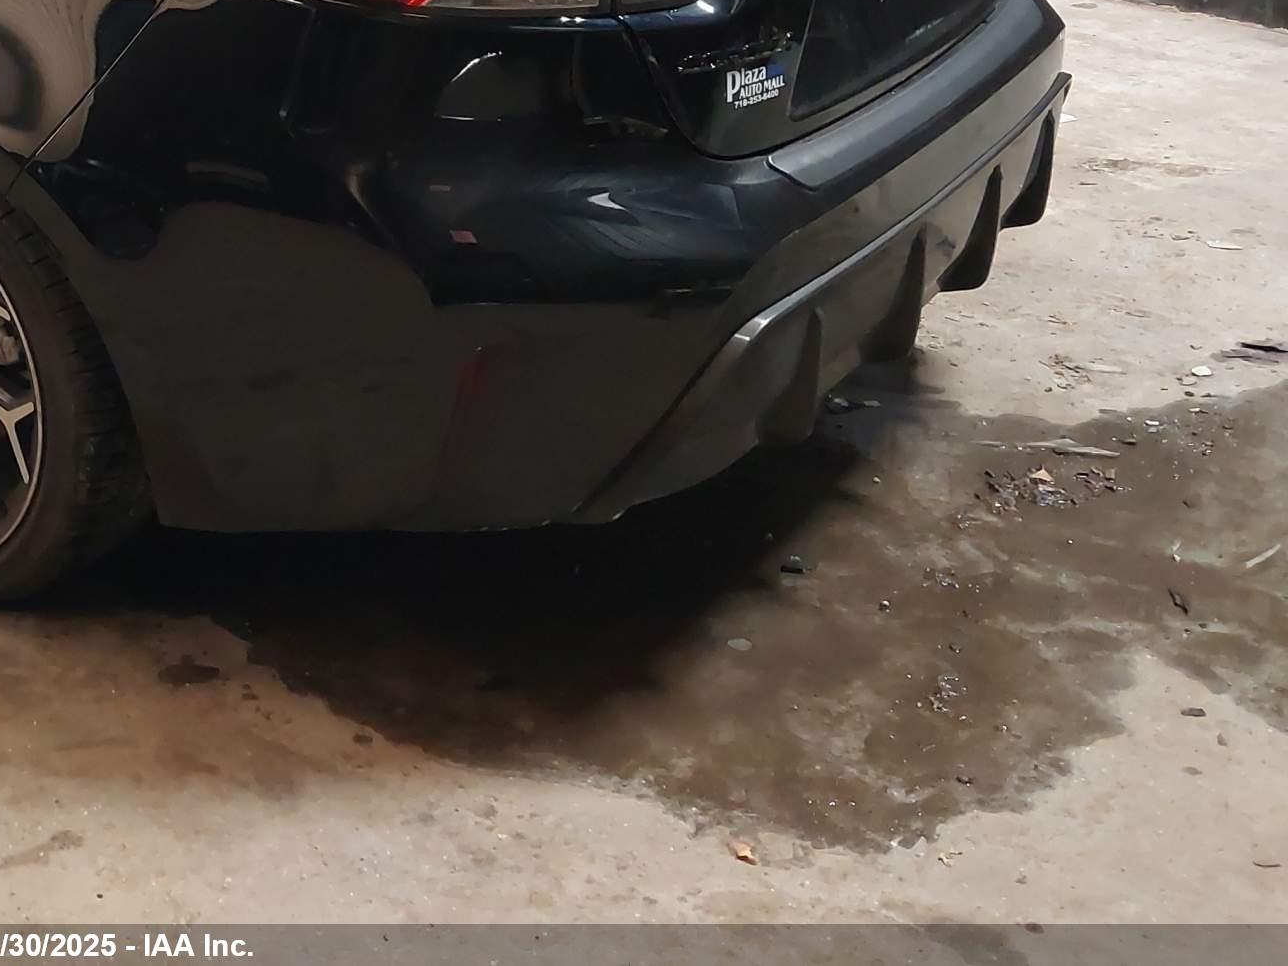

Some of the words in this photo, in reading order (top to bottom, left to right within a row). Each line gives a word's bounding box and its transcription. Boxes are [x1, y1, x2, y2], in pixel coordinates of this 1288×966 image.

[726, 66, 767, 103] Plaza
[739, 82, 763, 100] AUTO
[763, 75, 786, 92] MALL
